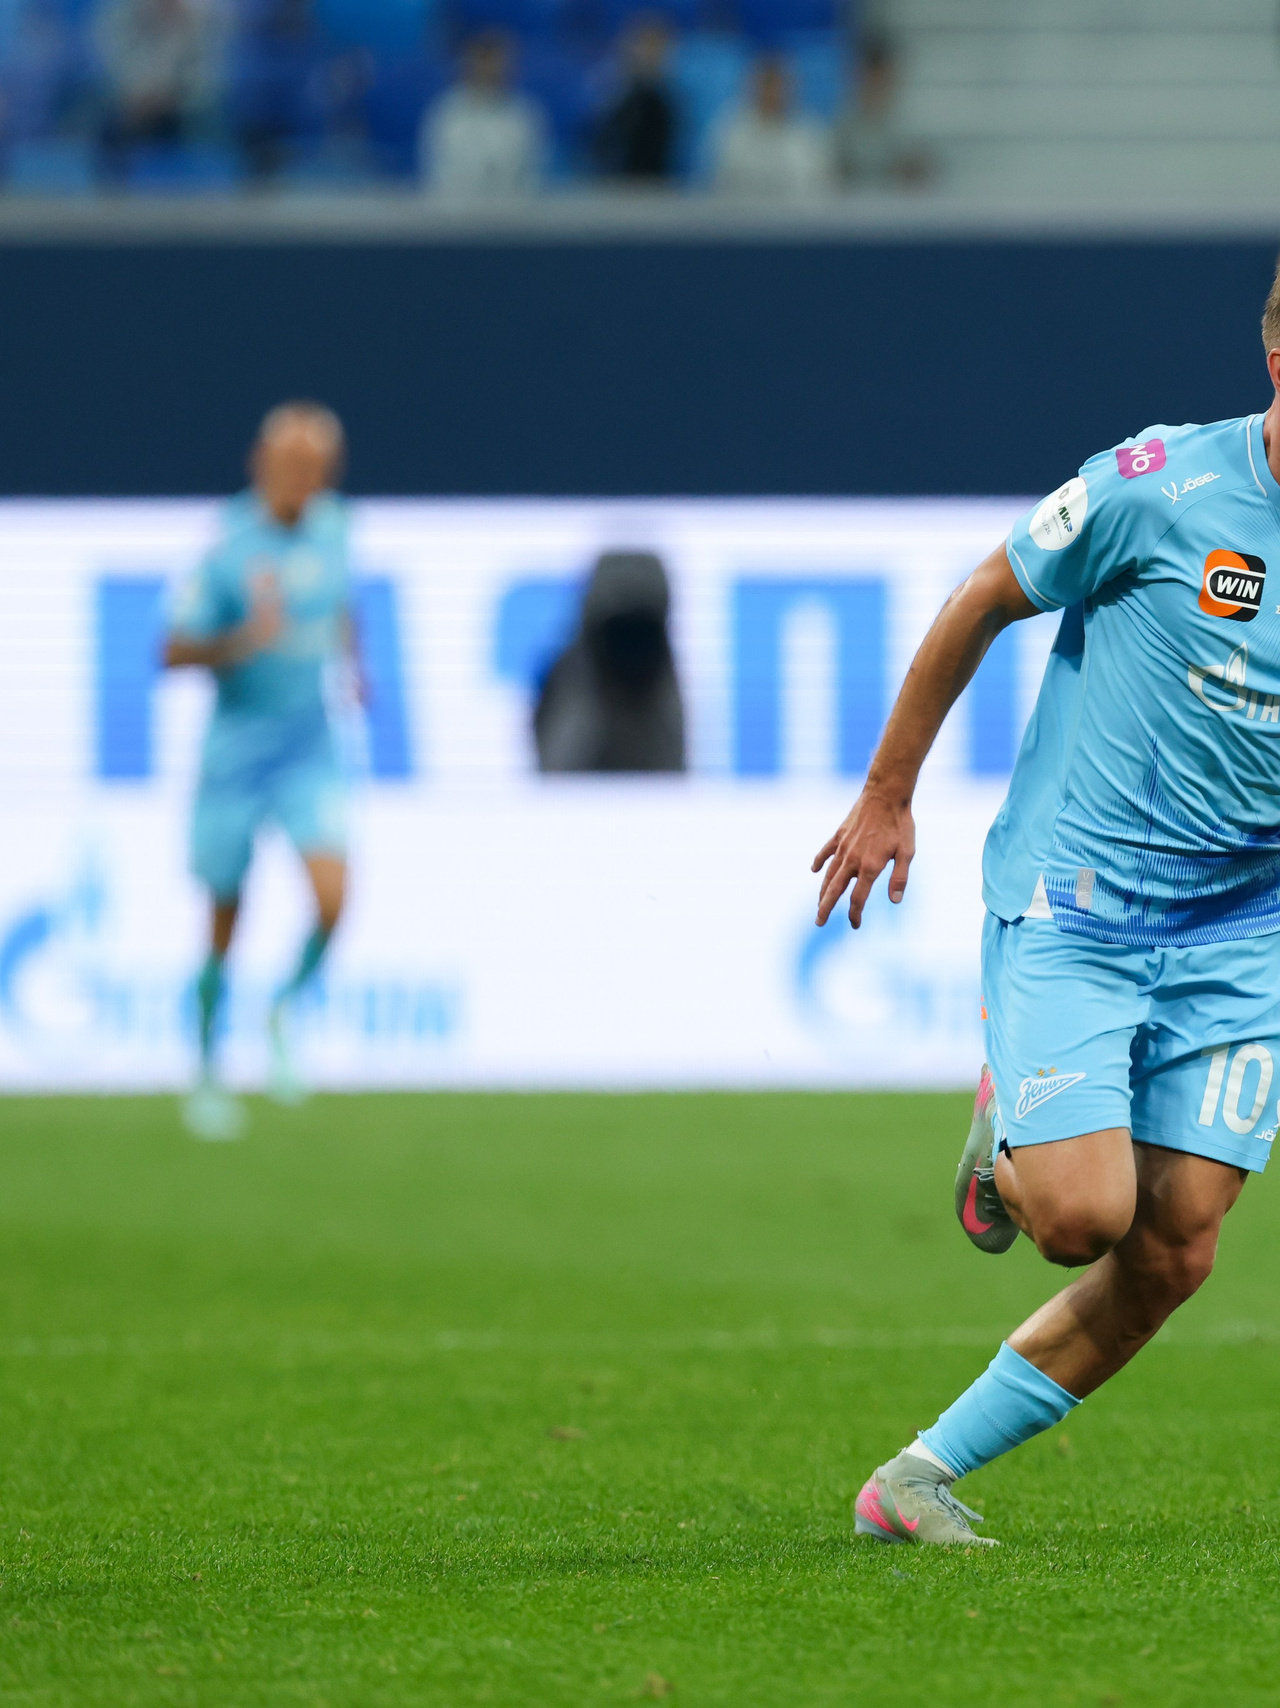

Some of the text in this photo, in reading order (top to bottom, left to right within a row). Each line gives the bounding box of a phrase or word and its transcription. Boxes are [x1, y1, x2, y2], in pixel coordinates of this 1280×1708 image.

[1180, 471, 1221, 494] JÖGEL
[1216, 574, 1260, 599] WIN
[1198, 1042, 1274, 1135] 10
